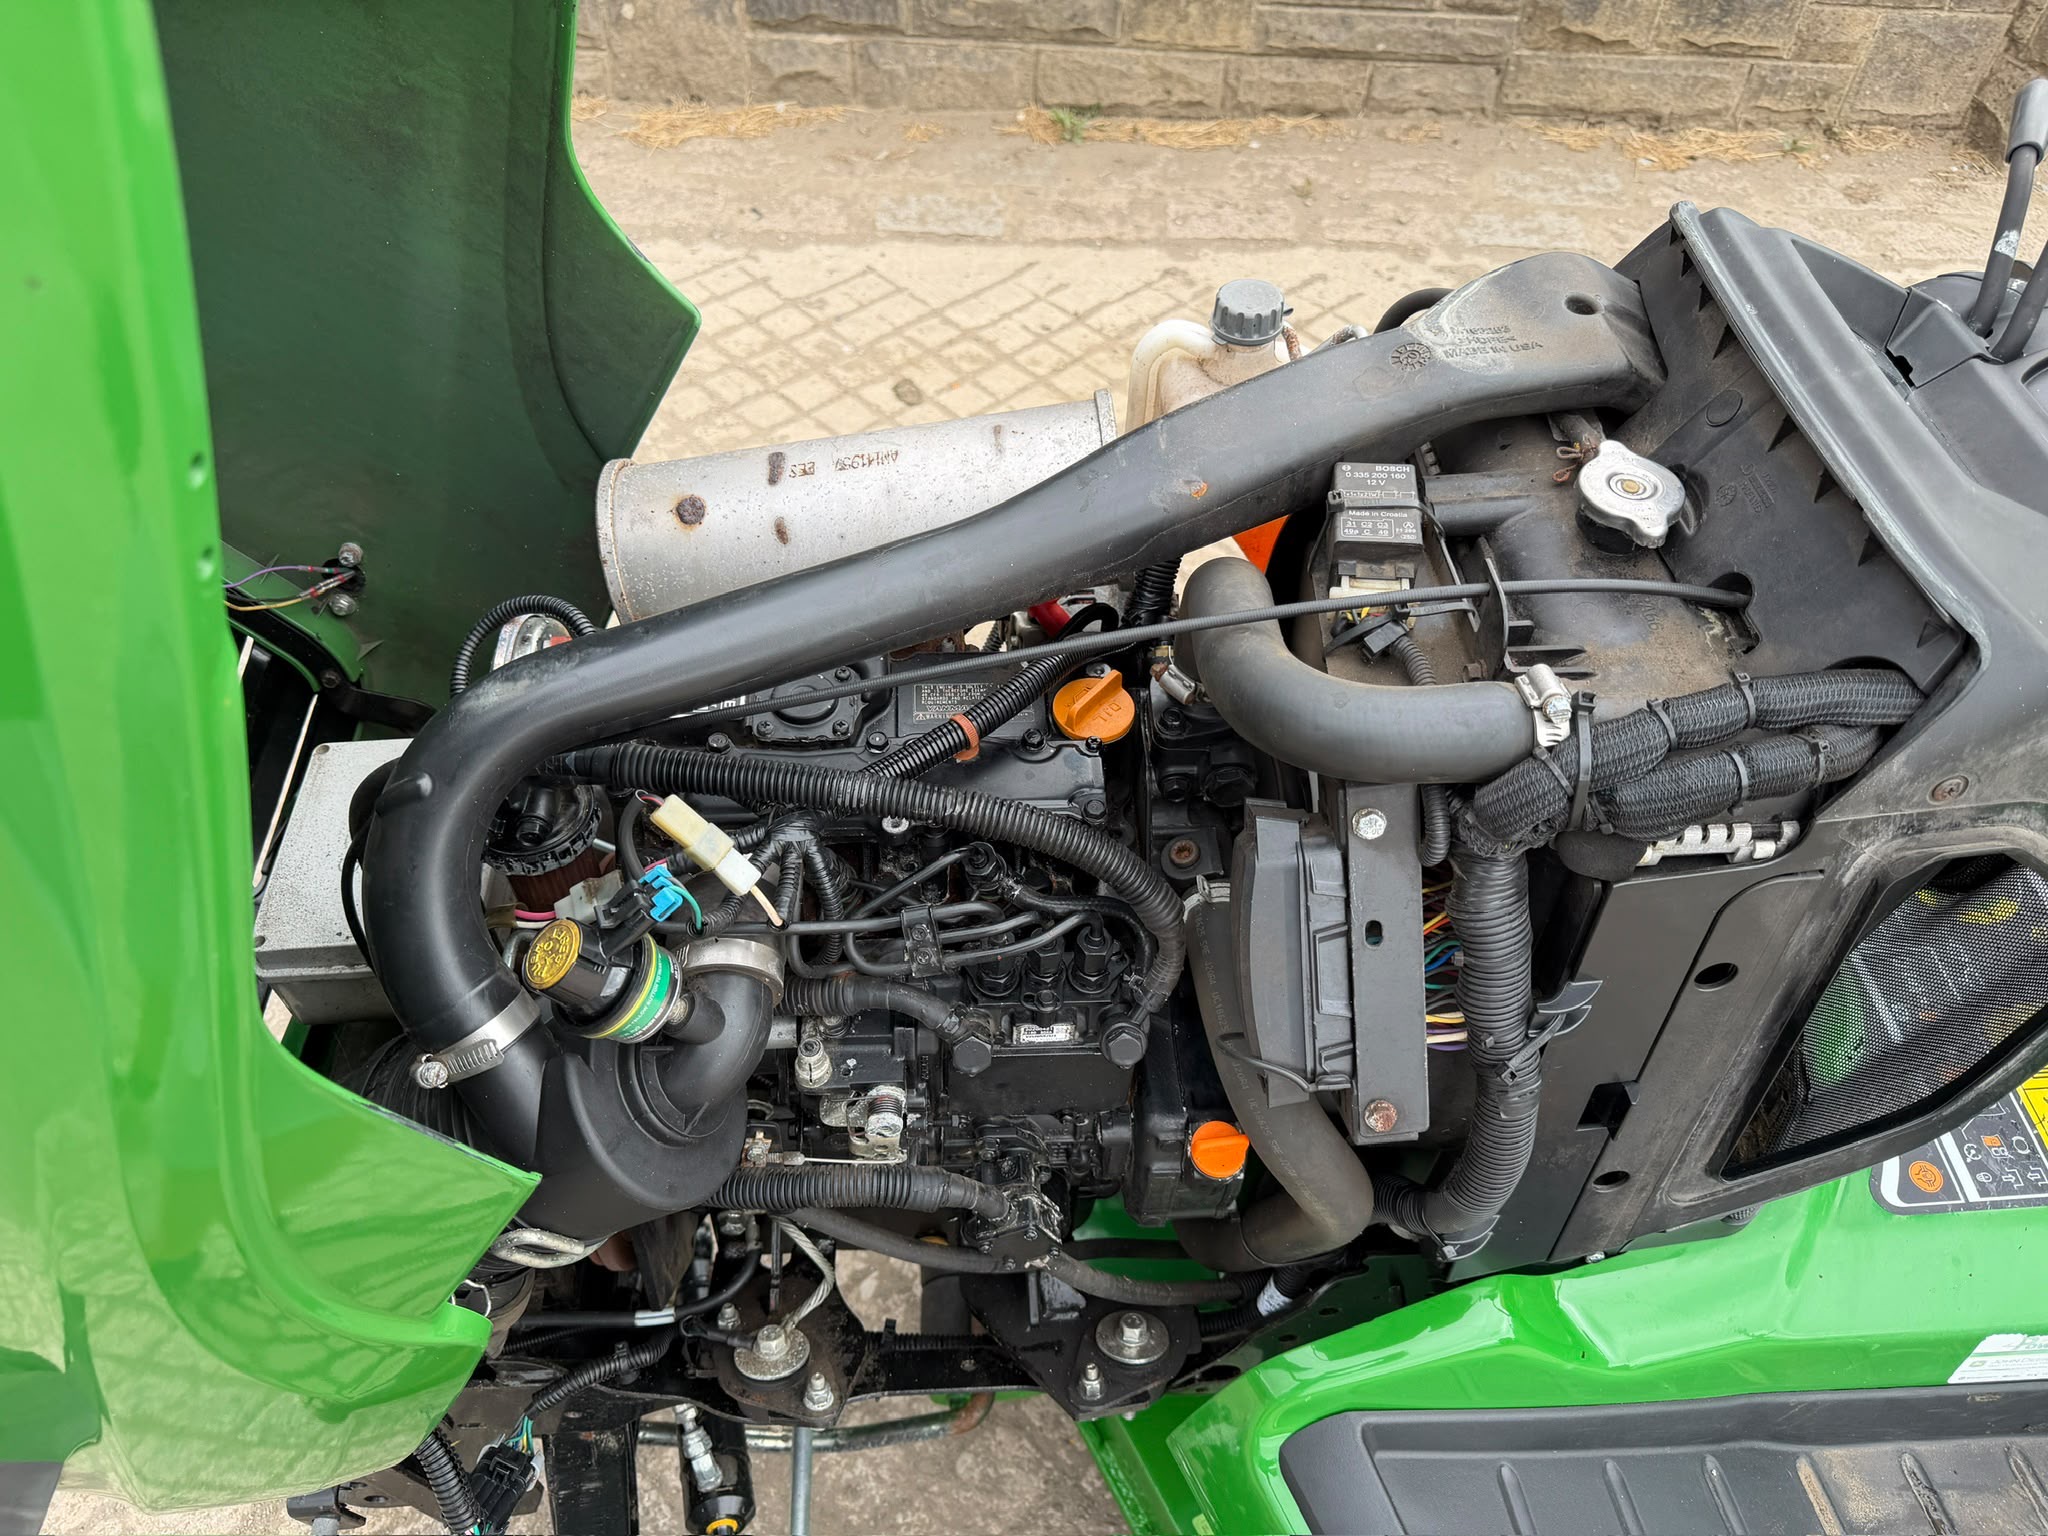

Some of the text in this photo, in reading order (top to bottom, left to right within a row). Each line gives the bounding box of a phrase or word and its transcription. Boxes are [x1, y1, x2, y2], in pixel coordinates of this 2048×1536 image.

[1443, 341, 1544, 359] MADE IN USA
